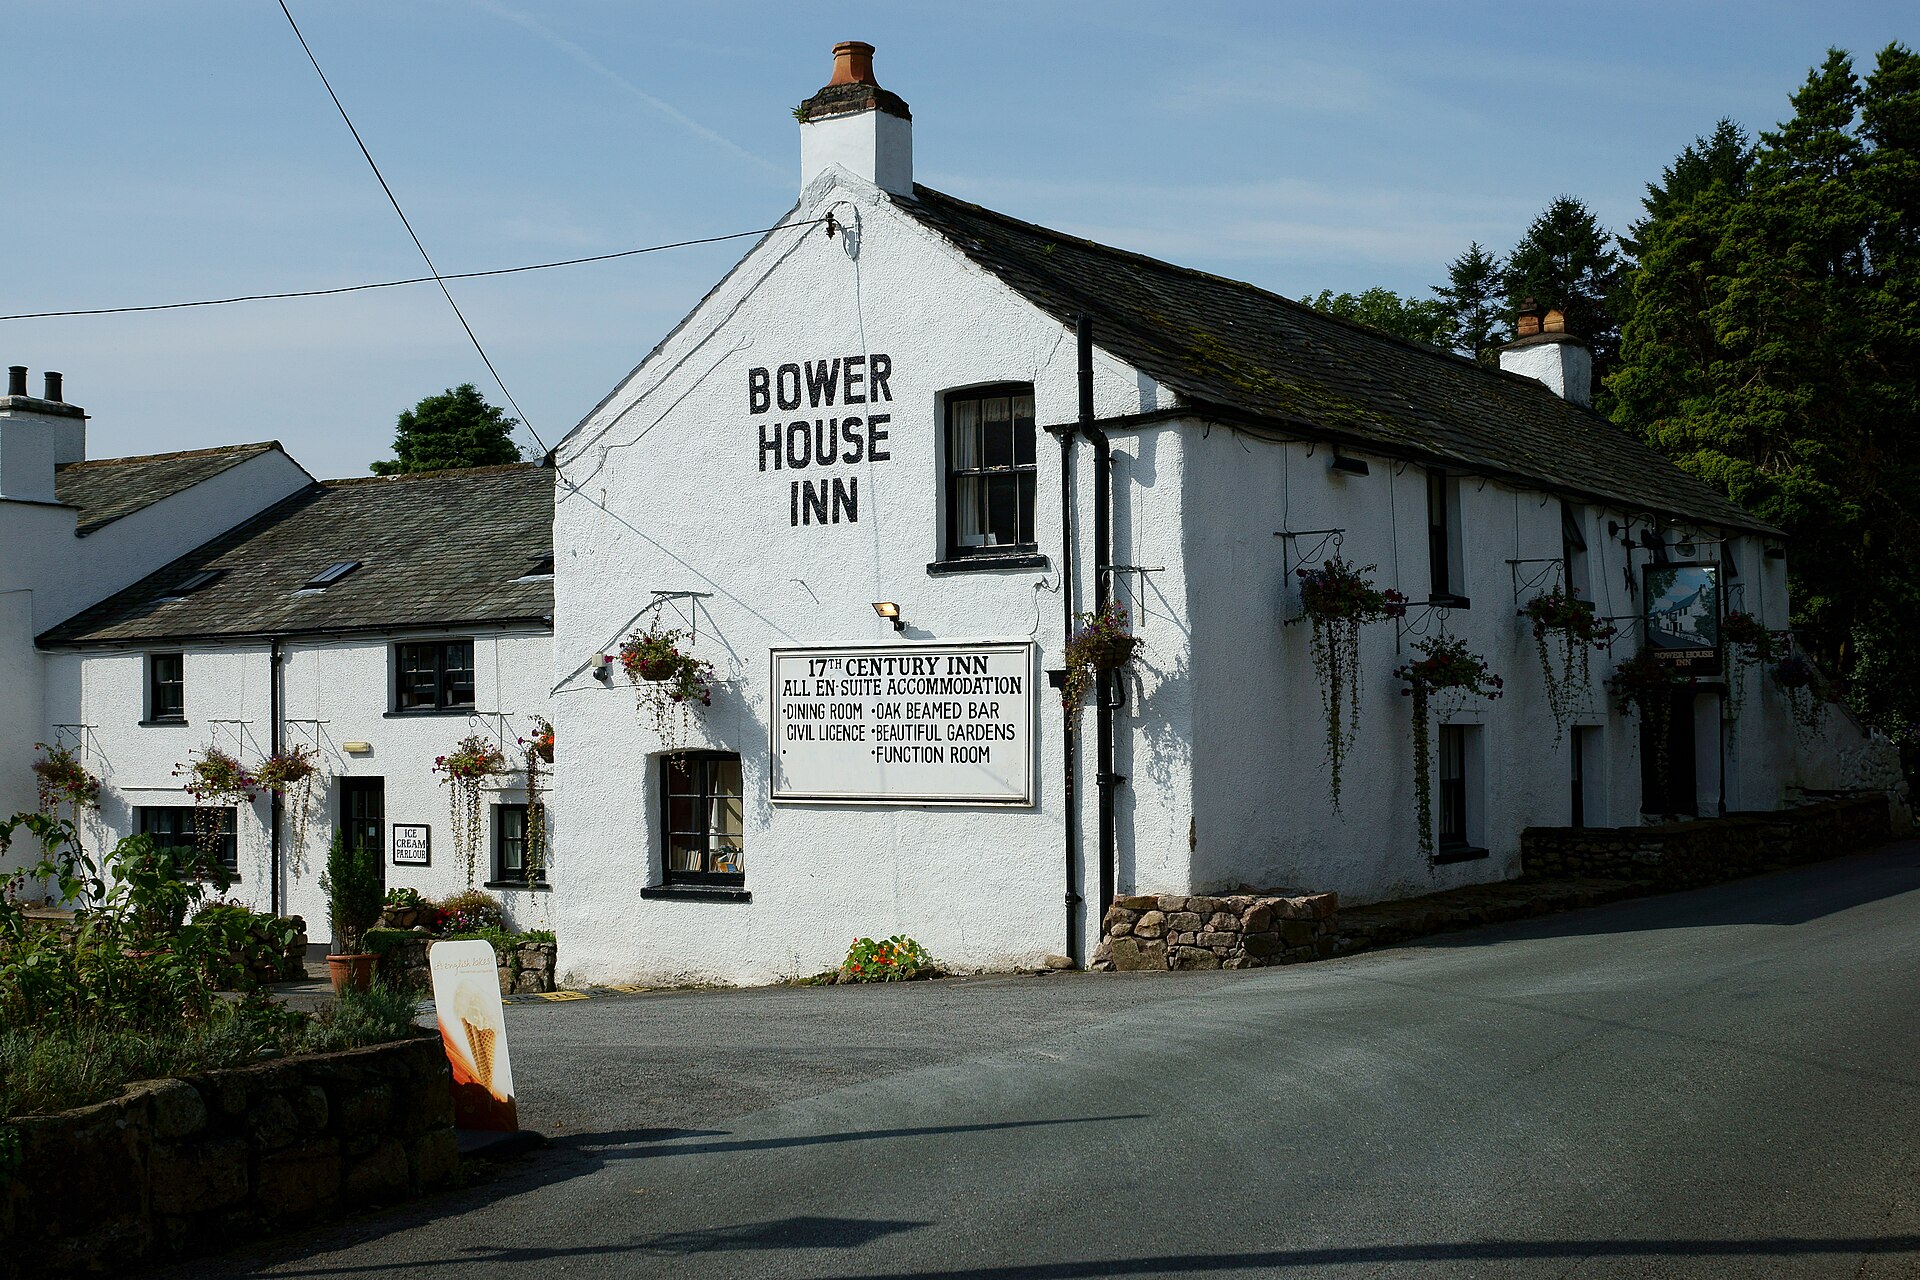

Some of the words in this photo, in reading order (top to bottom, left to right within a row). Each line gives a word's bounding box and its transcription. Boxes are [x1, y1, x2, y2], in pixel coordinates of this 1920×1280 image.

[749, 354, 893, 415] BOWER
[758, 414, 891, 471] HOUSE
[790, 477, 858, 527] INN
[1676, 659, 1692, 667] INN
[1685, 650, 1714, 659] HOUSE
[809, 658, 842, 677] 17TH
[846, 656, 940, 677] CENTURY
[947, 656, 989, 675] INN
[783, 680, 811, 697] ALL
[886, 676, 1022, 696] ACCOMMODATION
[787, 703, 825, 720] DINING
[830, 703, 863, 720] ROOM
[876, 702, 902, 720] OAK
[906, 702, 962, 719] BEAMED
[968, 701, 1000, 719] BAR
[787, 724, 815, 741] CIVIL
[820, 724, 865, 741] LICENCE
[876, 724, 942, 742] BEAUTIFUL
[947, 723, 1016, 741] GARDENS
[876, 746, 944, 763] FUNCTION
[950, 745, 990, 763] ROOM
[404, 828, 418, 838] ICE
[396, 838, 426, 849] CREAM
[396, 849, 426, 859] PARLOUR
